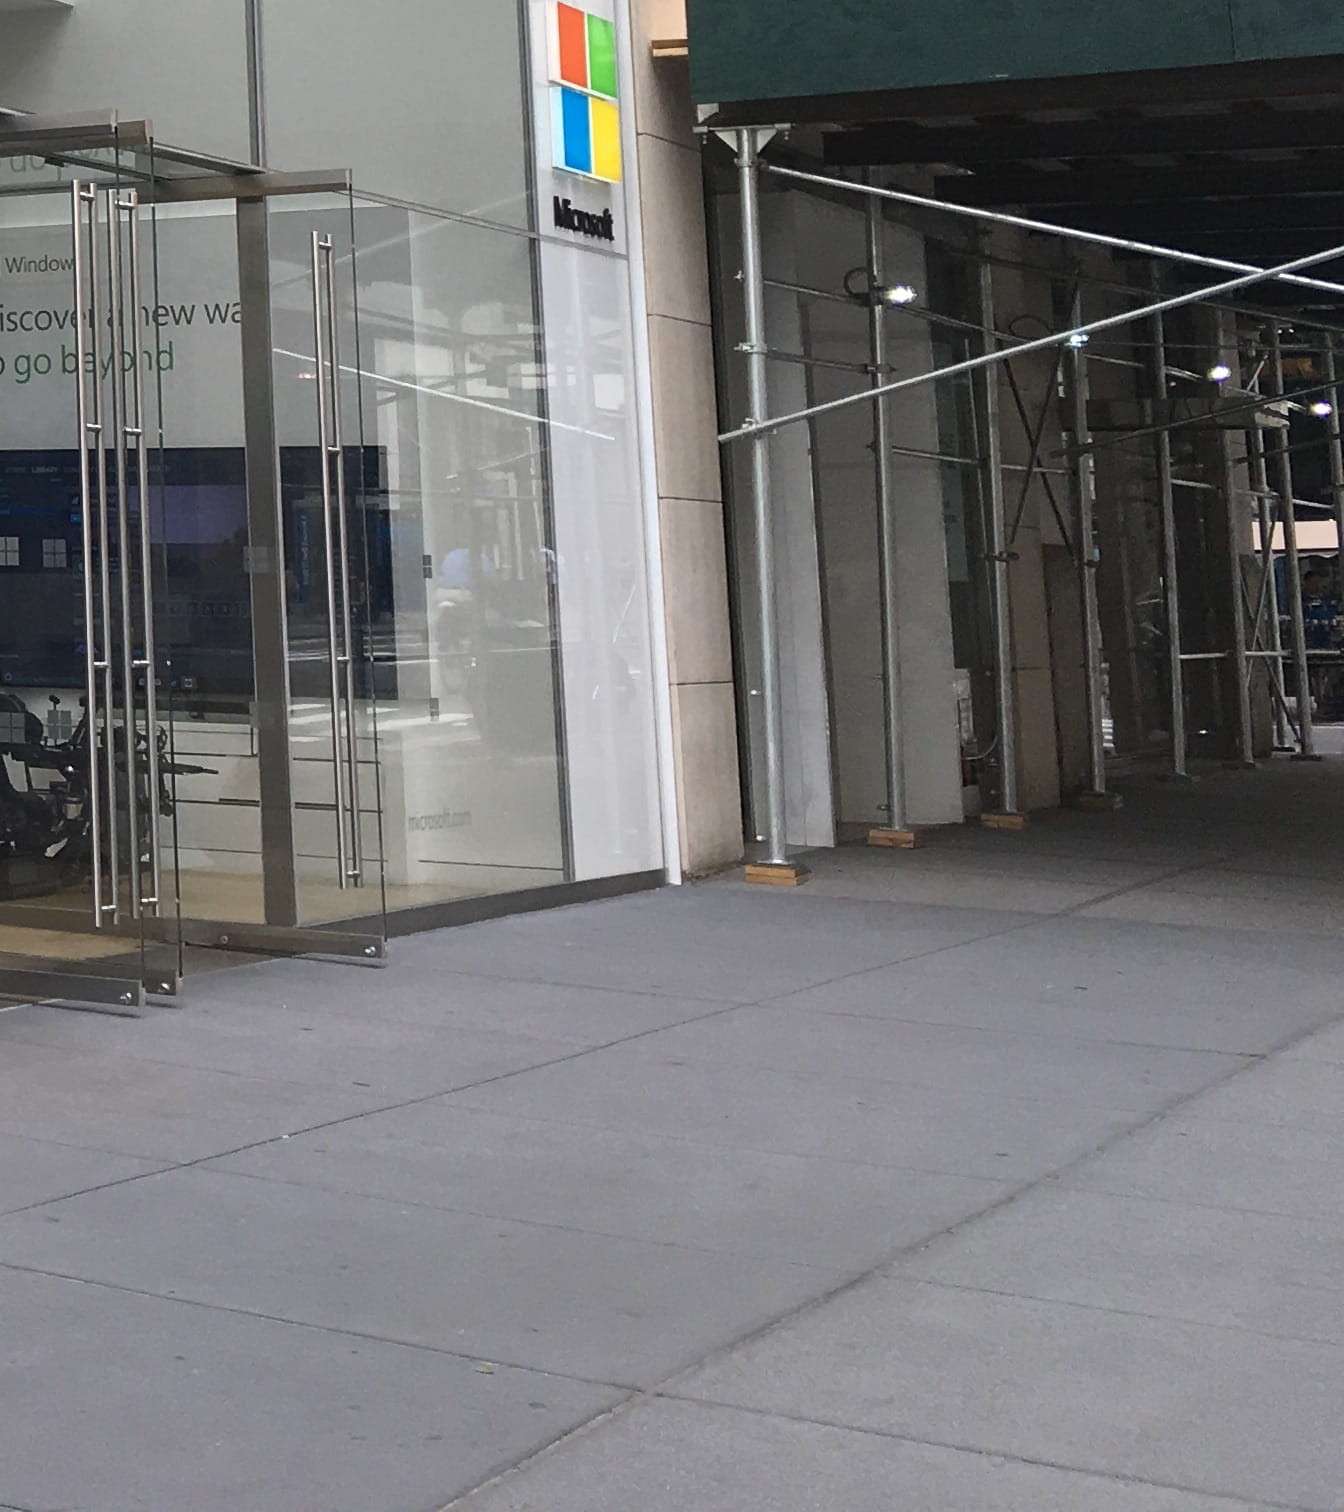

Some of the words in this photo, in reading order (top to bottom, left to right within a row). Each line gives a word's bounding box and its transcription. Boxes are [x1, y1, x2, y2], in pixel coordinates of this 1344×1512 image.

[553, 195, 614, 241] Microsoft
[5, 255, 76, 274] Window
[204, 302, 242, 325] wa
[14, 353, 52, 384] go
[62, 341, 174, 380] beyond
